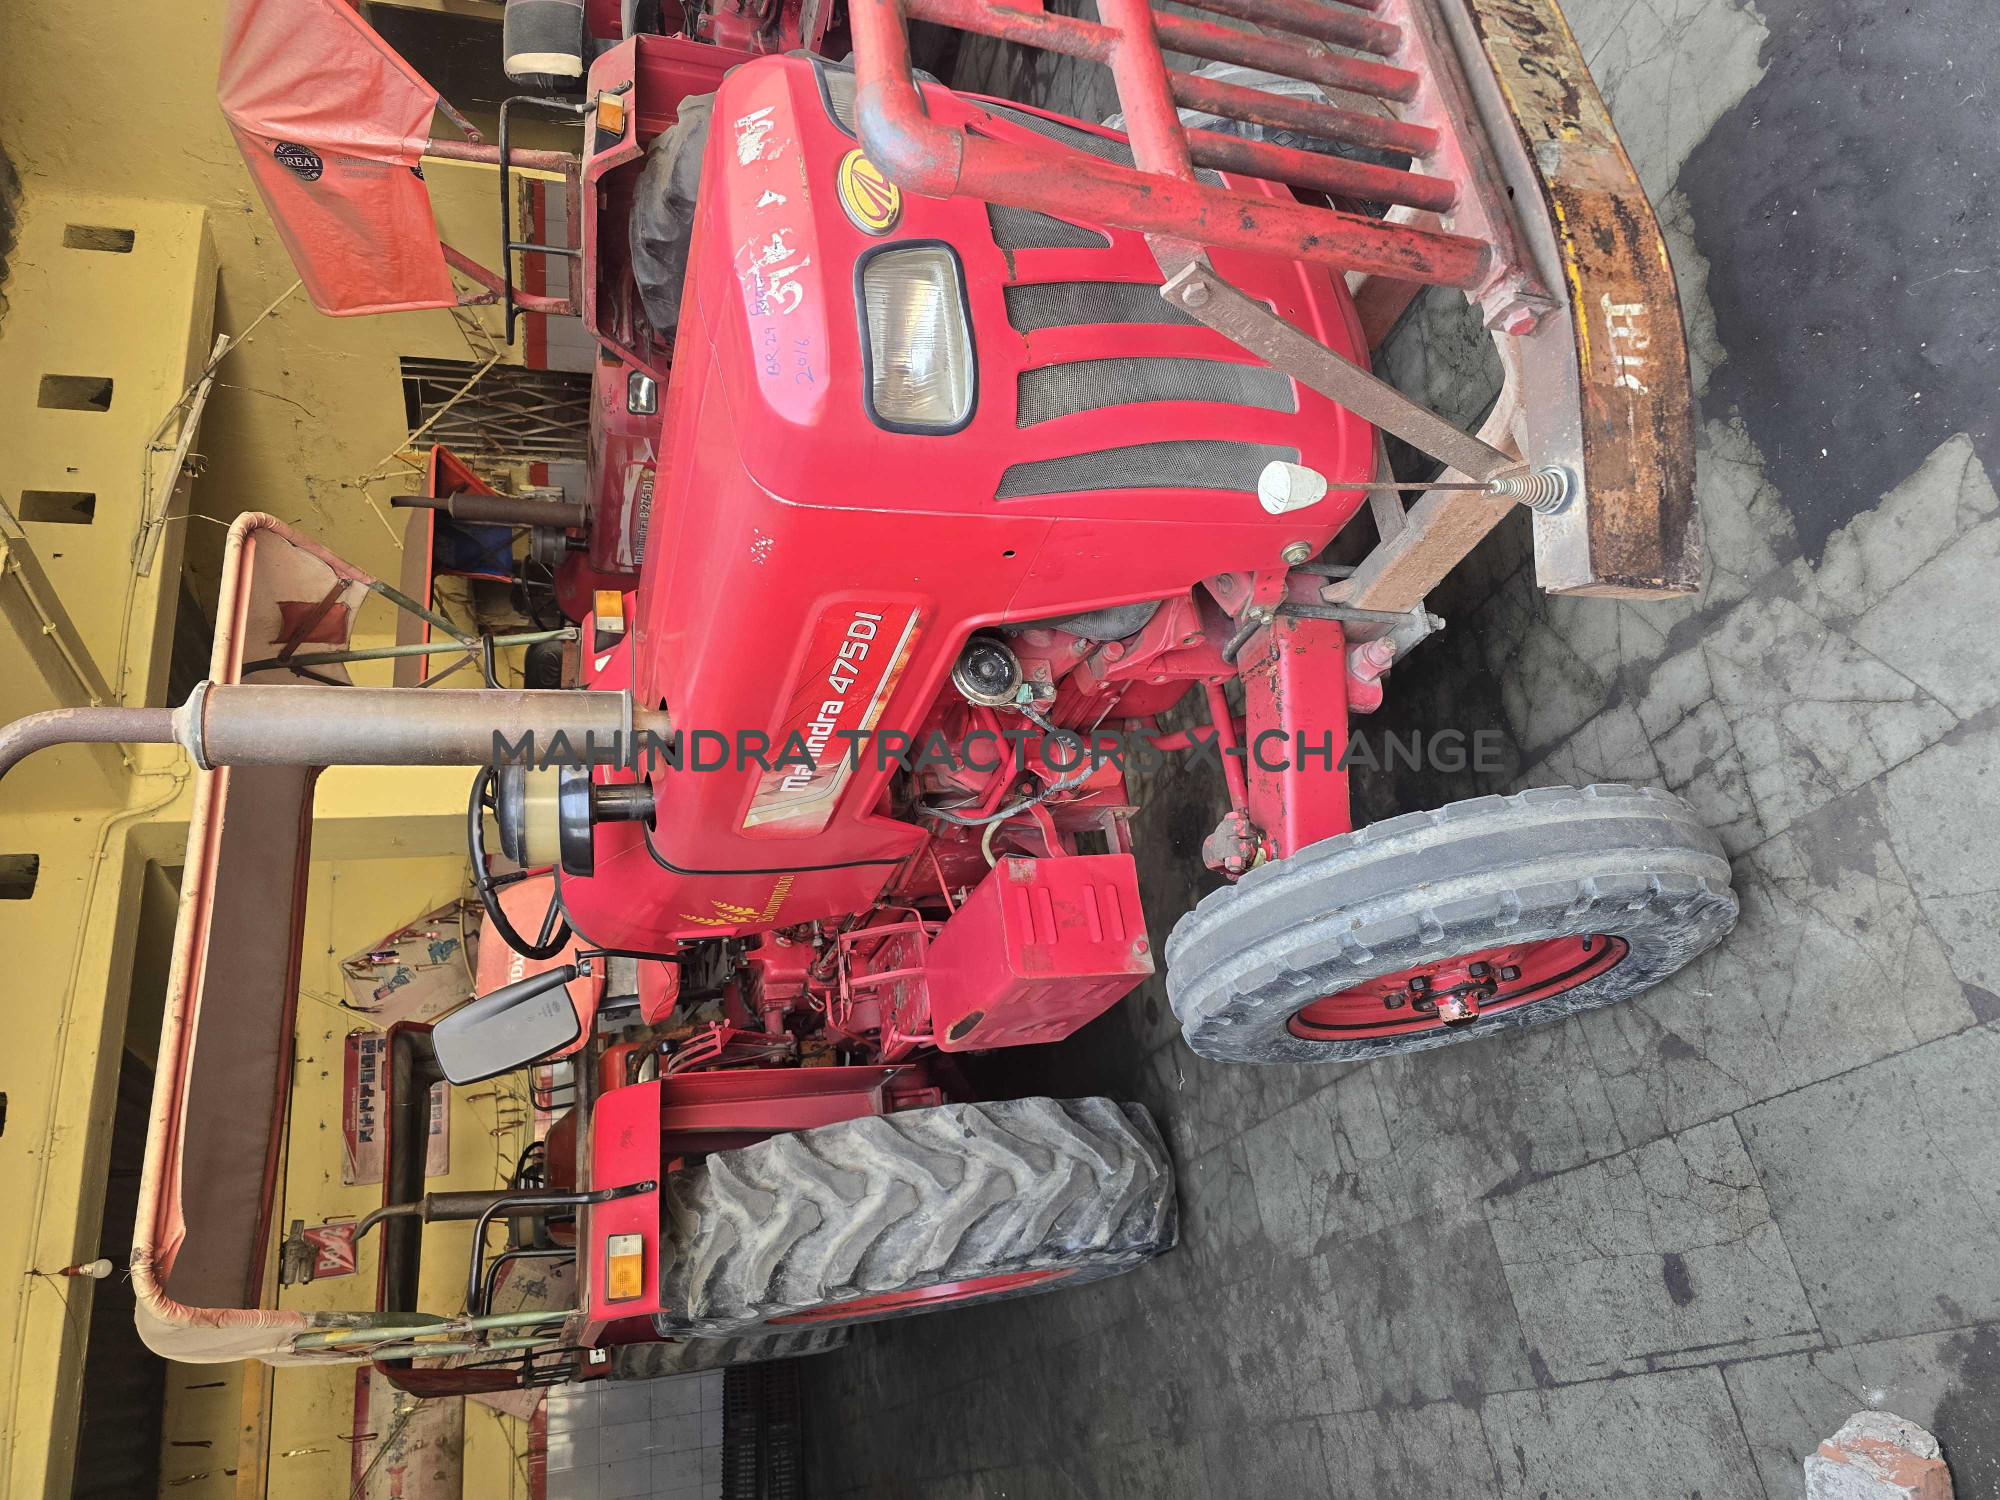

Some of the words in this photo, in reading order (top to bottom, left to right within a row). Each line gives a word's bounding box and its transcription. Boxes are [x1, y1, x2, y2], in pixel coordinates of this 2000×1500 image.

[277, 157, 319, 167] GREAT
[643, 481, 653, 491] DI
[640, 493, 652, 509] 275
[828, 611, 883, 694] 475DI
[319, 1242, 346, 1270] Bay
